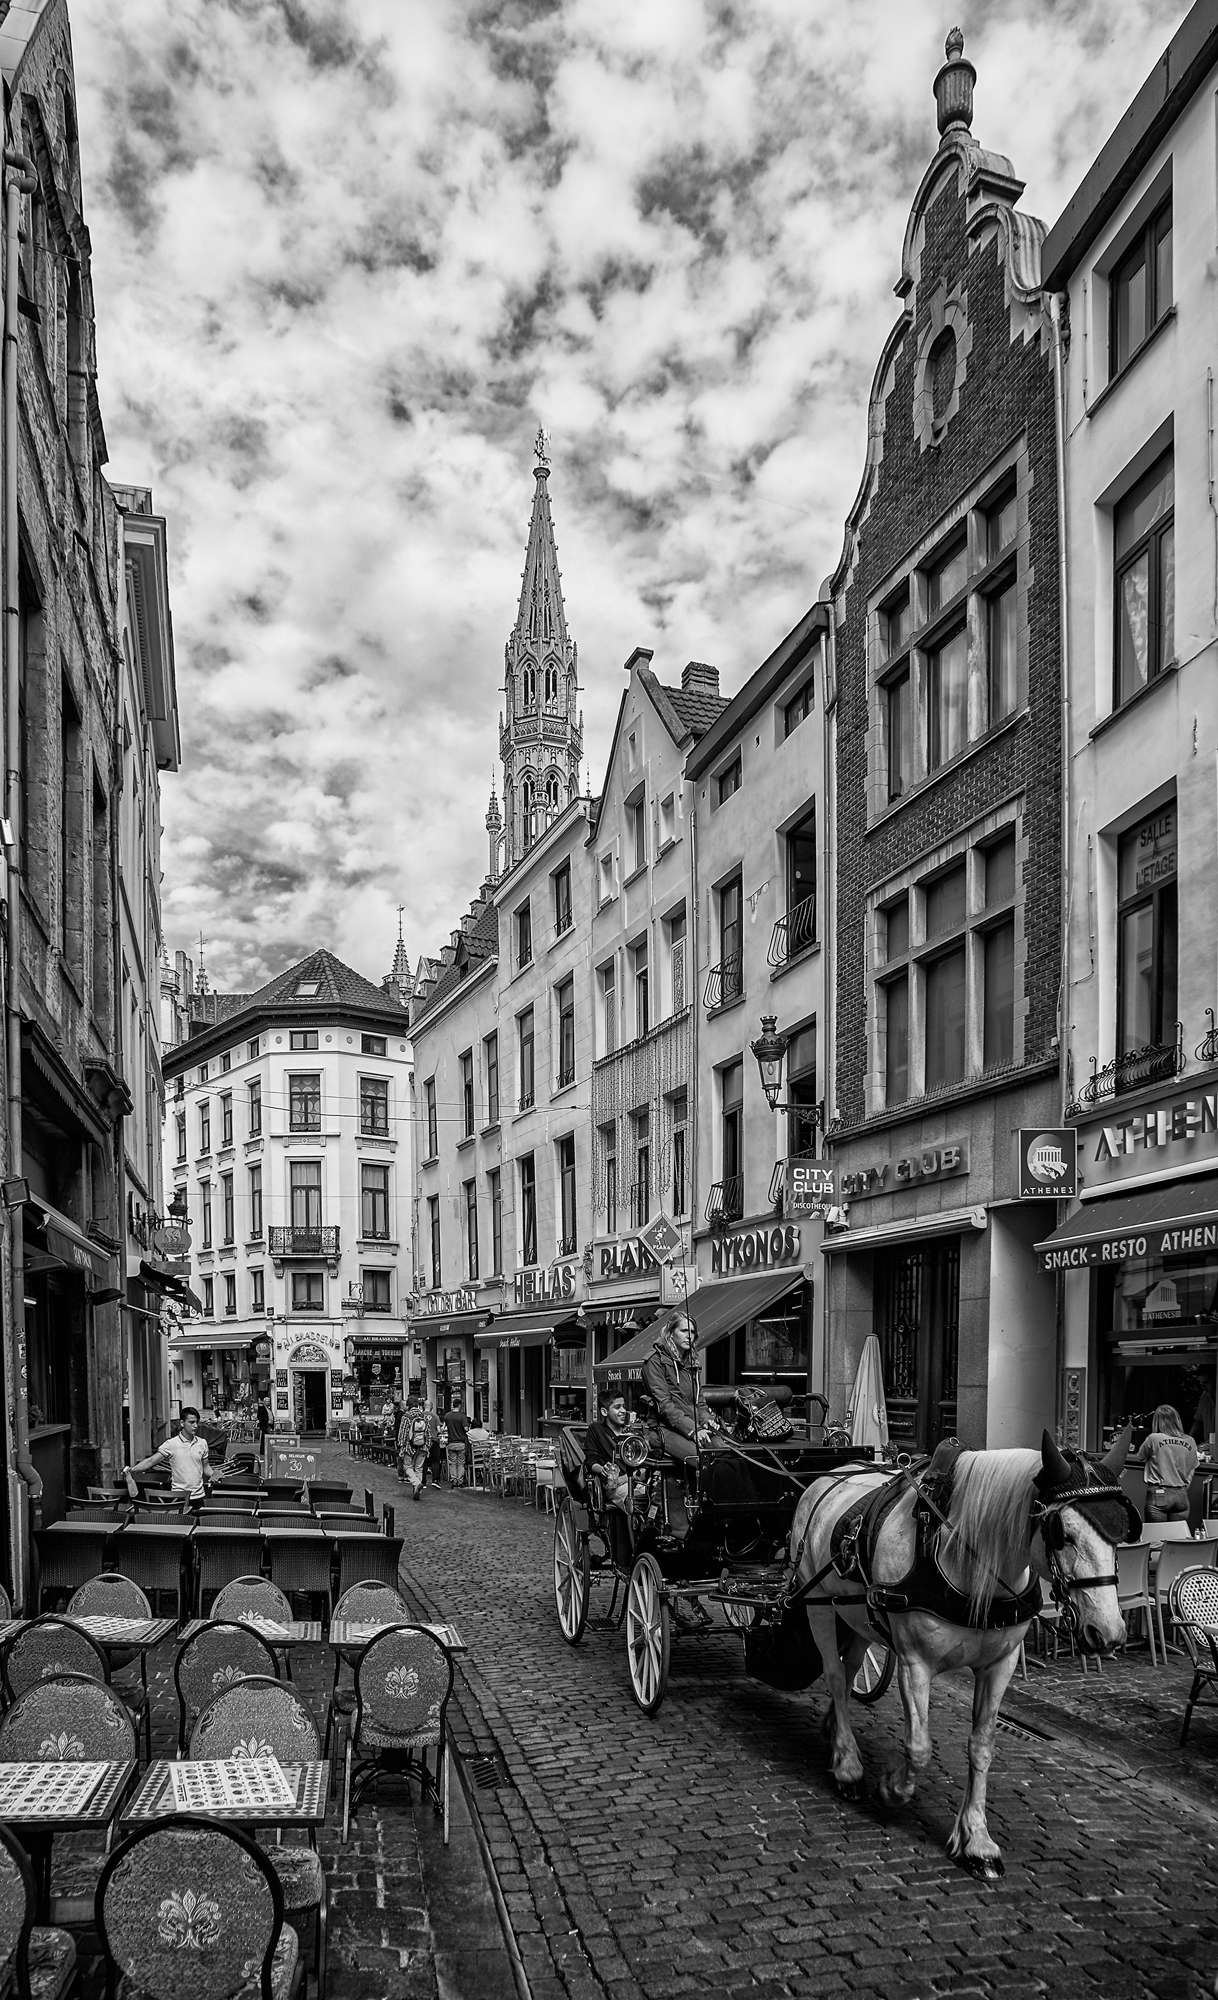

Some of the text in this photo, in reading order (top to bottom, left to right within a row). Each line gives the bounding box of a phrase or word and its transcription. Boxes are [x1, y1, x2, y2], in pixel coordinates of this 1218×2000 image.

[1141, 814, 1171, 847] SALLE
[1136, 852, 1175, 890] L'ETAGE
[1094, 1092, 1218, 1162] ATHEN
[793, 1168, 834, 1180] CITY
[793, 1181, 834, 1194] CLUB
[841, 1146, 961, 1195] CITY CLUB
[1023, 1187, 1074, 1195] ATHENES
[601, 1237, 660, 1276] PLAK
[712, 1225, 801, 1279] MYKONOS
[1045, 1246, 1088, 1270] SNACK
[1102, 1236, 1147, 1261] RESTO
[1160, 1225, 1217, 1252] ATHEN
[514, 1265, 576, 1304] HELLAS
[1147, 1311, 1176, 1320] ATHENES
[608, 1369, 622, 1380] Snack
[1158, 1438, 1192, 1452] ATHENES
